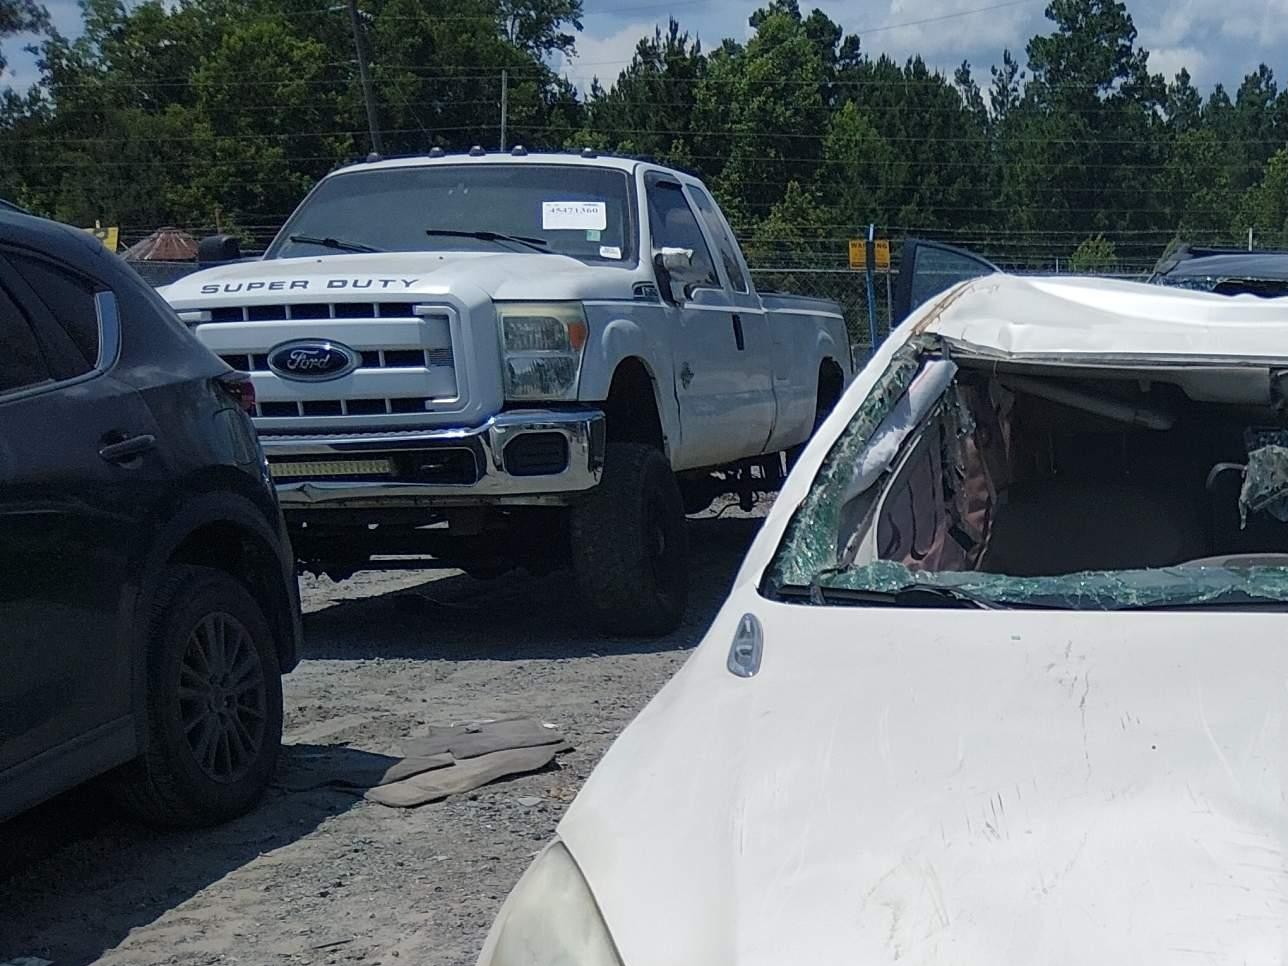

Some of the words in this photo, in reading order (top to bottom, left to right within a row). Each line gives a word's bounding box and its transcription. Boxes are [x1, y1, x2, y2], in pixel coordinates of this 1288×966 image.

[200, 280, 309, 294] SUPER
[326, 279, 419, 289] DUTY
[286, 350, 330, 370] Ford
